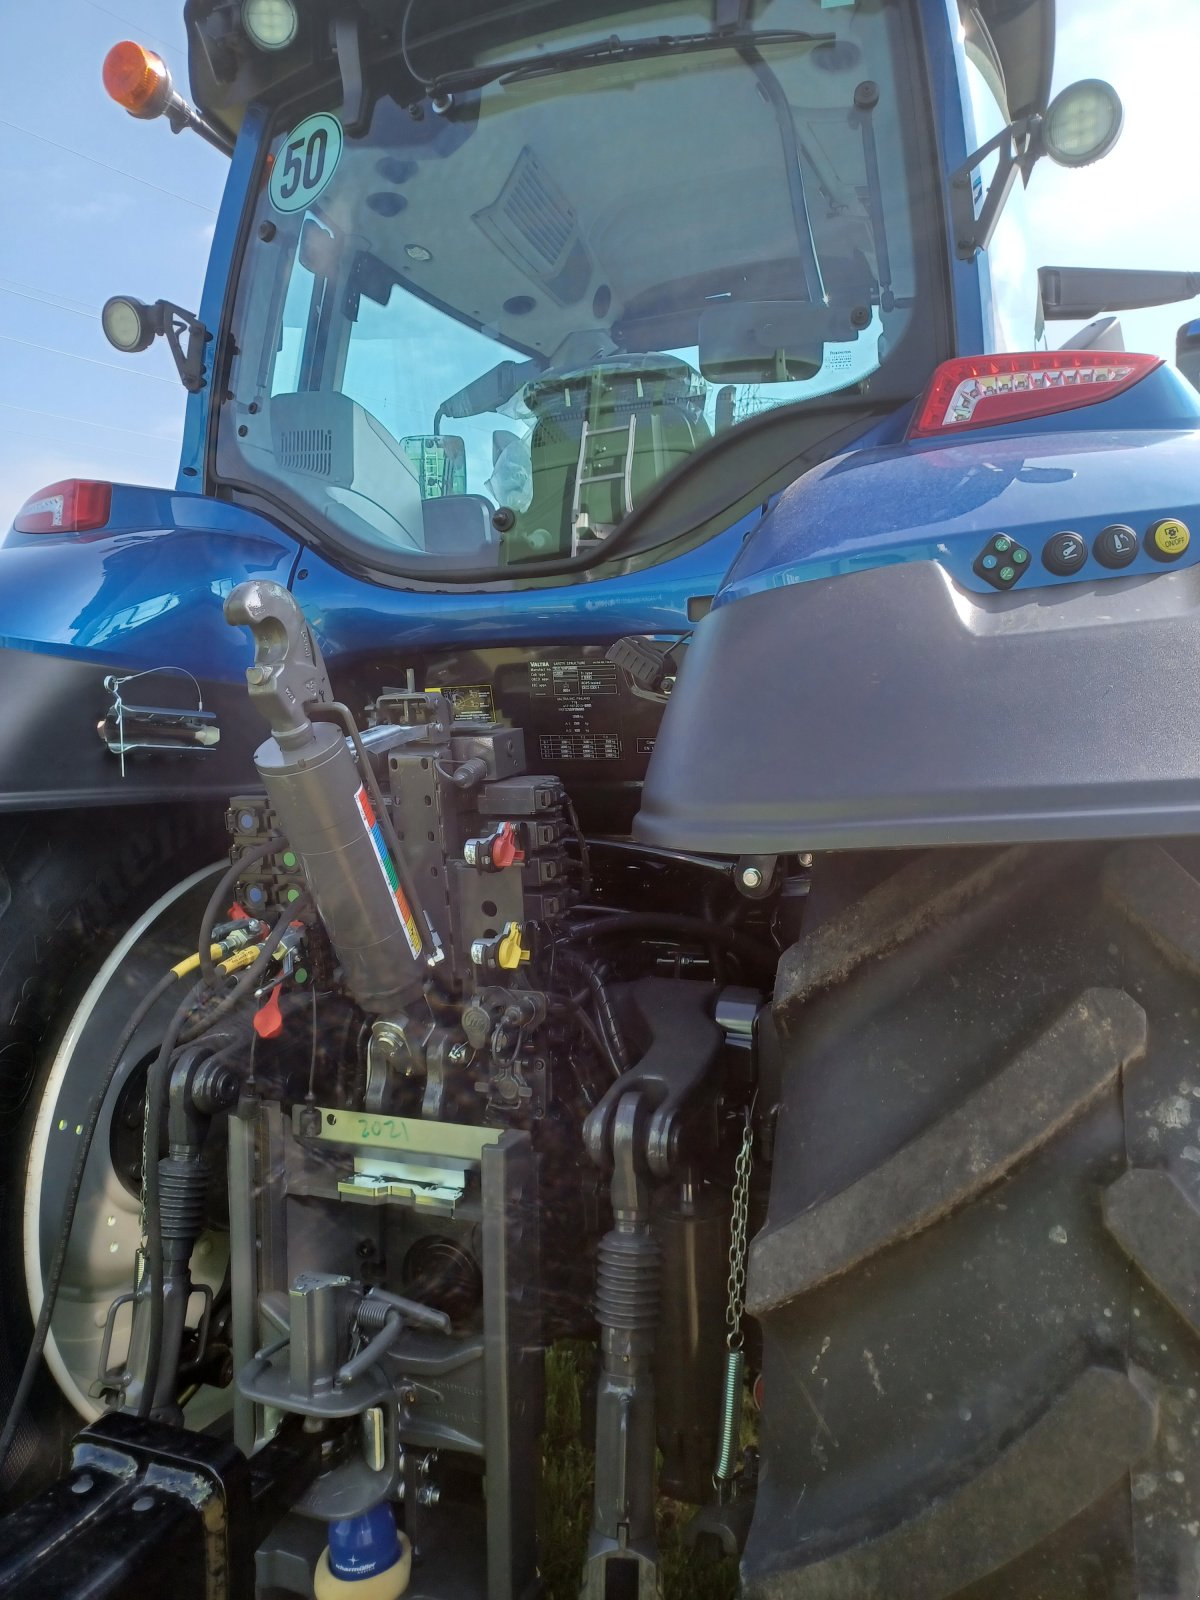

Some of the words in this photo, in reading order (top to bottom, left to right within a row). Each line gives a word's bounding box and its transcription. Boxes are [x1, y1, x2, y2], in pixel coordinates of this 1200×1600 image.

[281, 128, 328, 199] 50
[1165, 537, 1184, 547] ON/OFF
[358, 1119, 409, 1142] 2021
